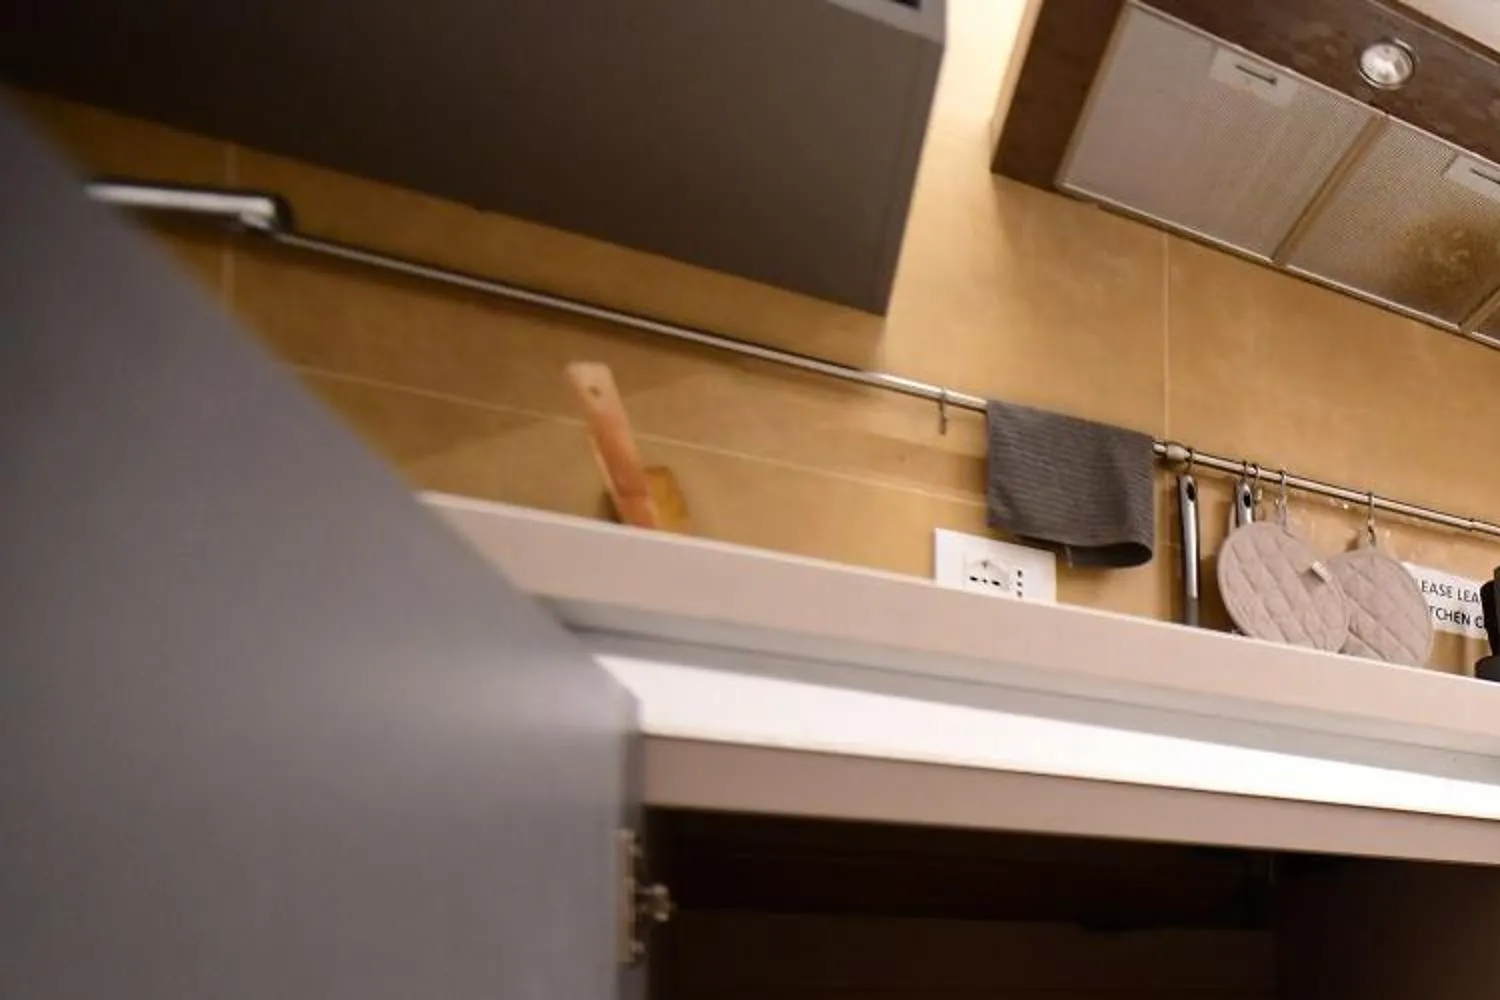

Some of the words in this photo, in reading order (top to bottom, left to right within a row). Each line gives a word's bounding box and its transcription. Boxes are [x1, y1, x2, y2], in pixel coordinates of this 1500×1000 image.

[1457, 588, 1480, 603] LEA
[1429, 606, 1470, 625] TCHEN
[1474, 616, 1484, 629] C
